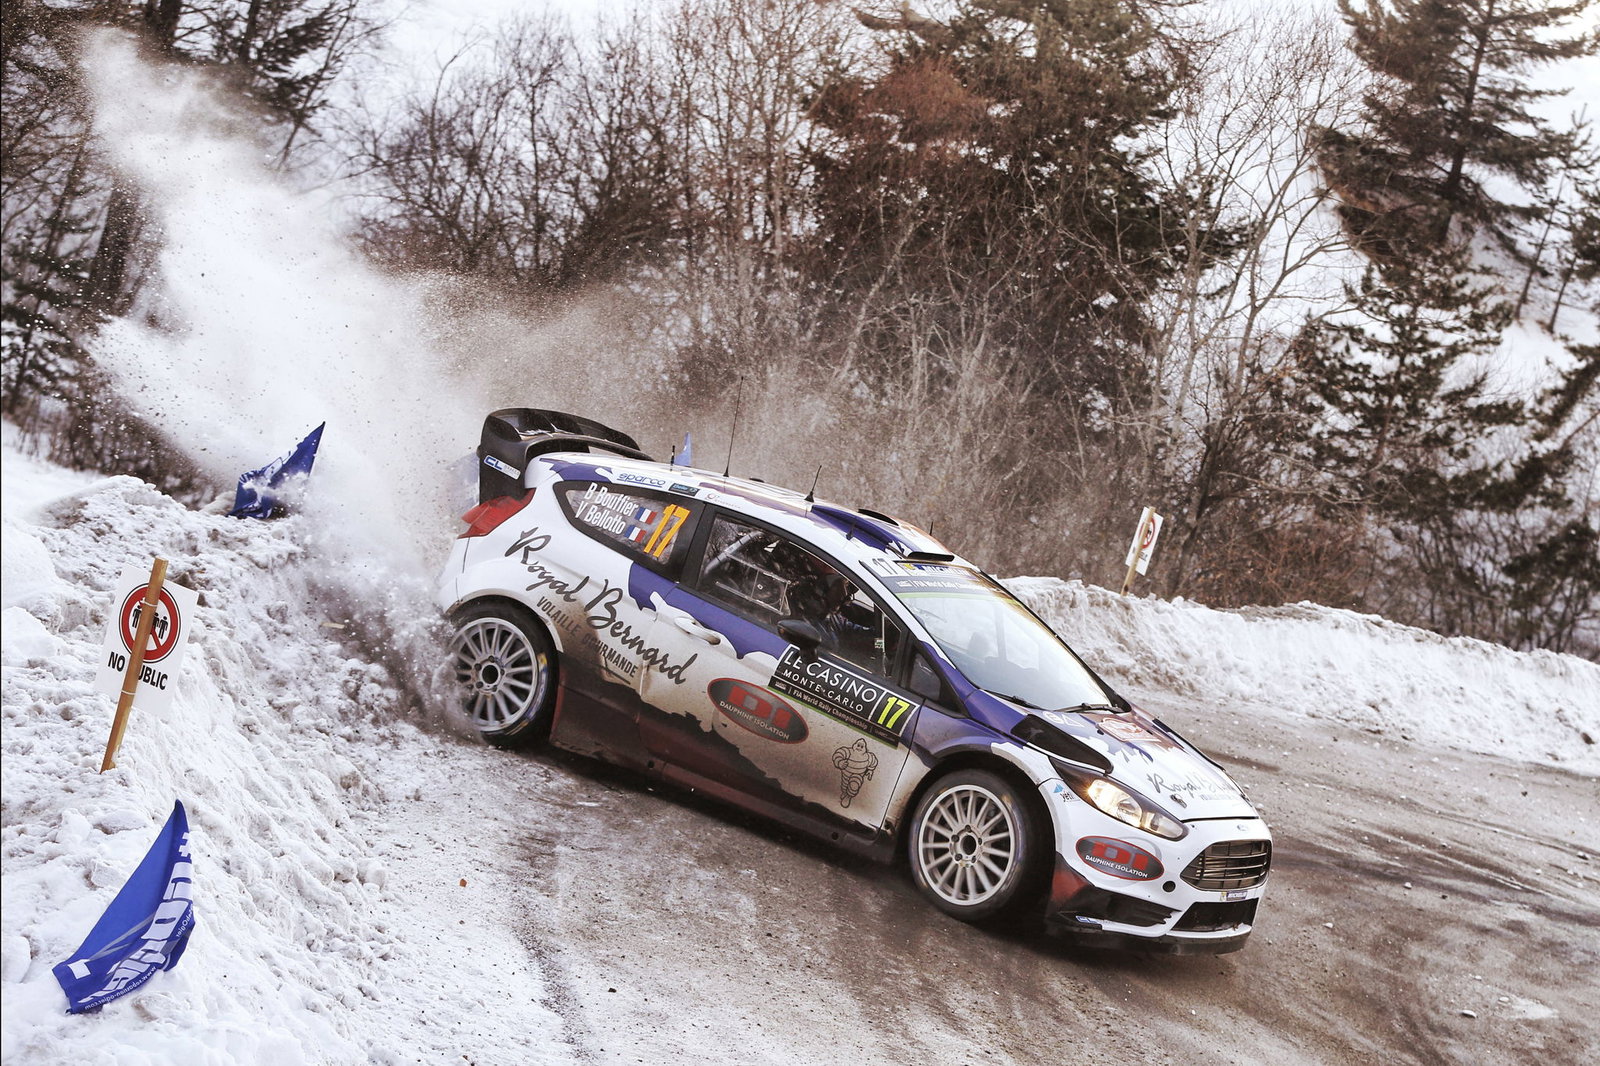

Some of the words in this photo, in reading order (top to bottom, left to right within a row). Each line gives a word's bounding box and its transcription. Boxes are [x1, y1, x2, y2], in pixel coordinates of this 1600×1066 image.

[485, 456, 503, 470] CL
[619, 472, 666, 485] sparco
[575, 501, 585, 518] V
[584, 505, 626, 535] Bellotto
[584, 482, 598, 500] B
[595, 487, 639, 517] Bouffier
[643, 503, 691, 558] 17
[504, 526, 590, 602] Royal
[584, 578, 698, 685] Bernard
[536, 596, 582, 636] VOLAILLE
[108, 651, 126, 672] NO
[138, 665, 168, 690] UBLIC
[784, 651, 803, 670] LE
[806, 662, 877, 703] CASINO
[720, 701, 754, 721] DAUPHINE
[754, 718, 790, 740] ISOLATION
[793, 690, 802, 698] FIA
[803, 693, 818, 706] World
[818, 701, 832, 712] Rally
[832, 708, 868, 730] Championship
[877, 696, 910, 729] 17
[1085, 855, 1115, 868] DAUPHINE
[1115, 863, 1148, 879] ISOLATION
